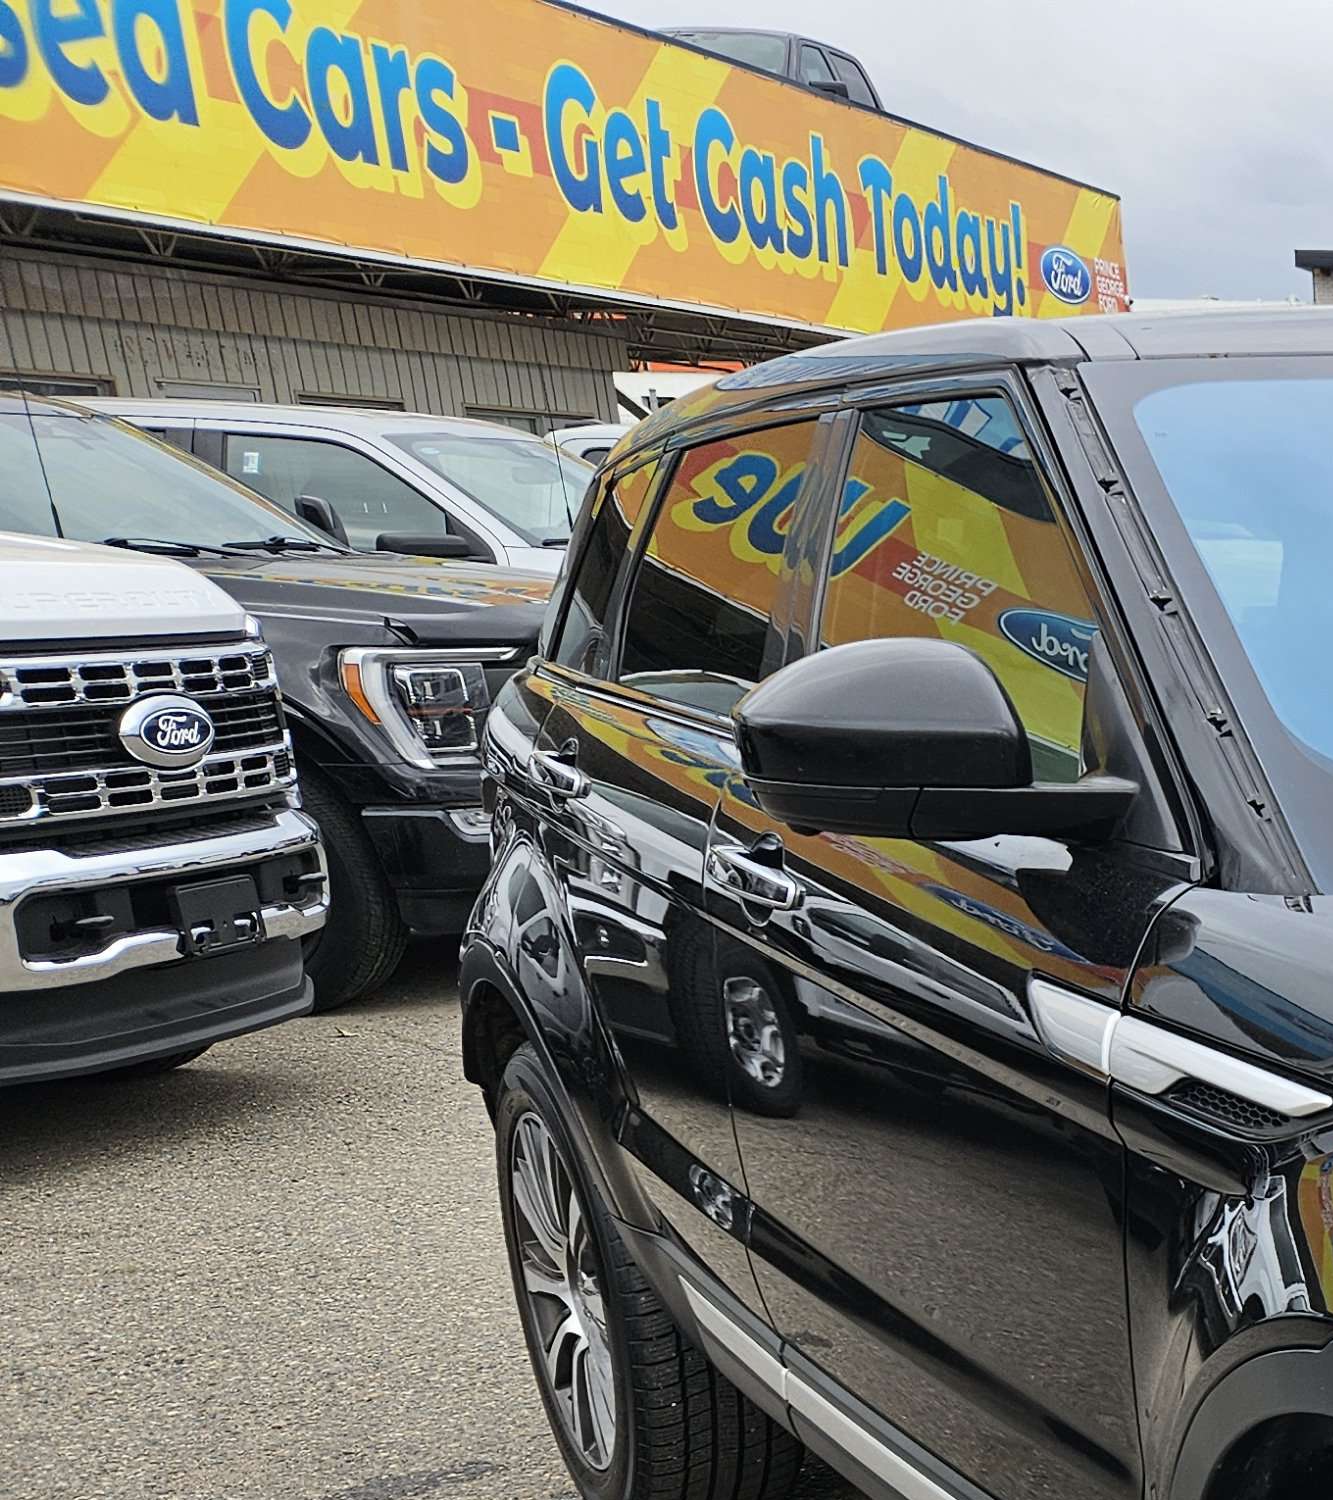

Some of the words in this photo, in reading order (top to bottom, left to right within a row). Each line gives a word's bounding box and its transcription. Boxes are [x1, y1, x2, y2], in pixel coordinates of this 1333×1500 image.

[224, 0, 470, 184] Cars
[543, 62, 678, 230] Get
[694, 107, 849, 268] Cash
[858, 156, 1026, 316] Today!
[1094, 257, 1121, 280] PRINCE
[1096, 275, 1126, 299] GEORGE
[156, 715, 201, 747] Ford
